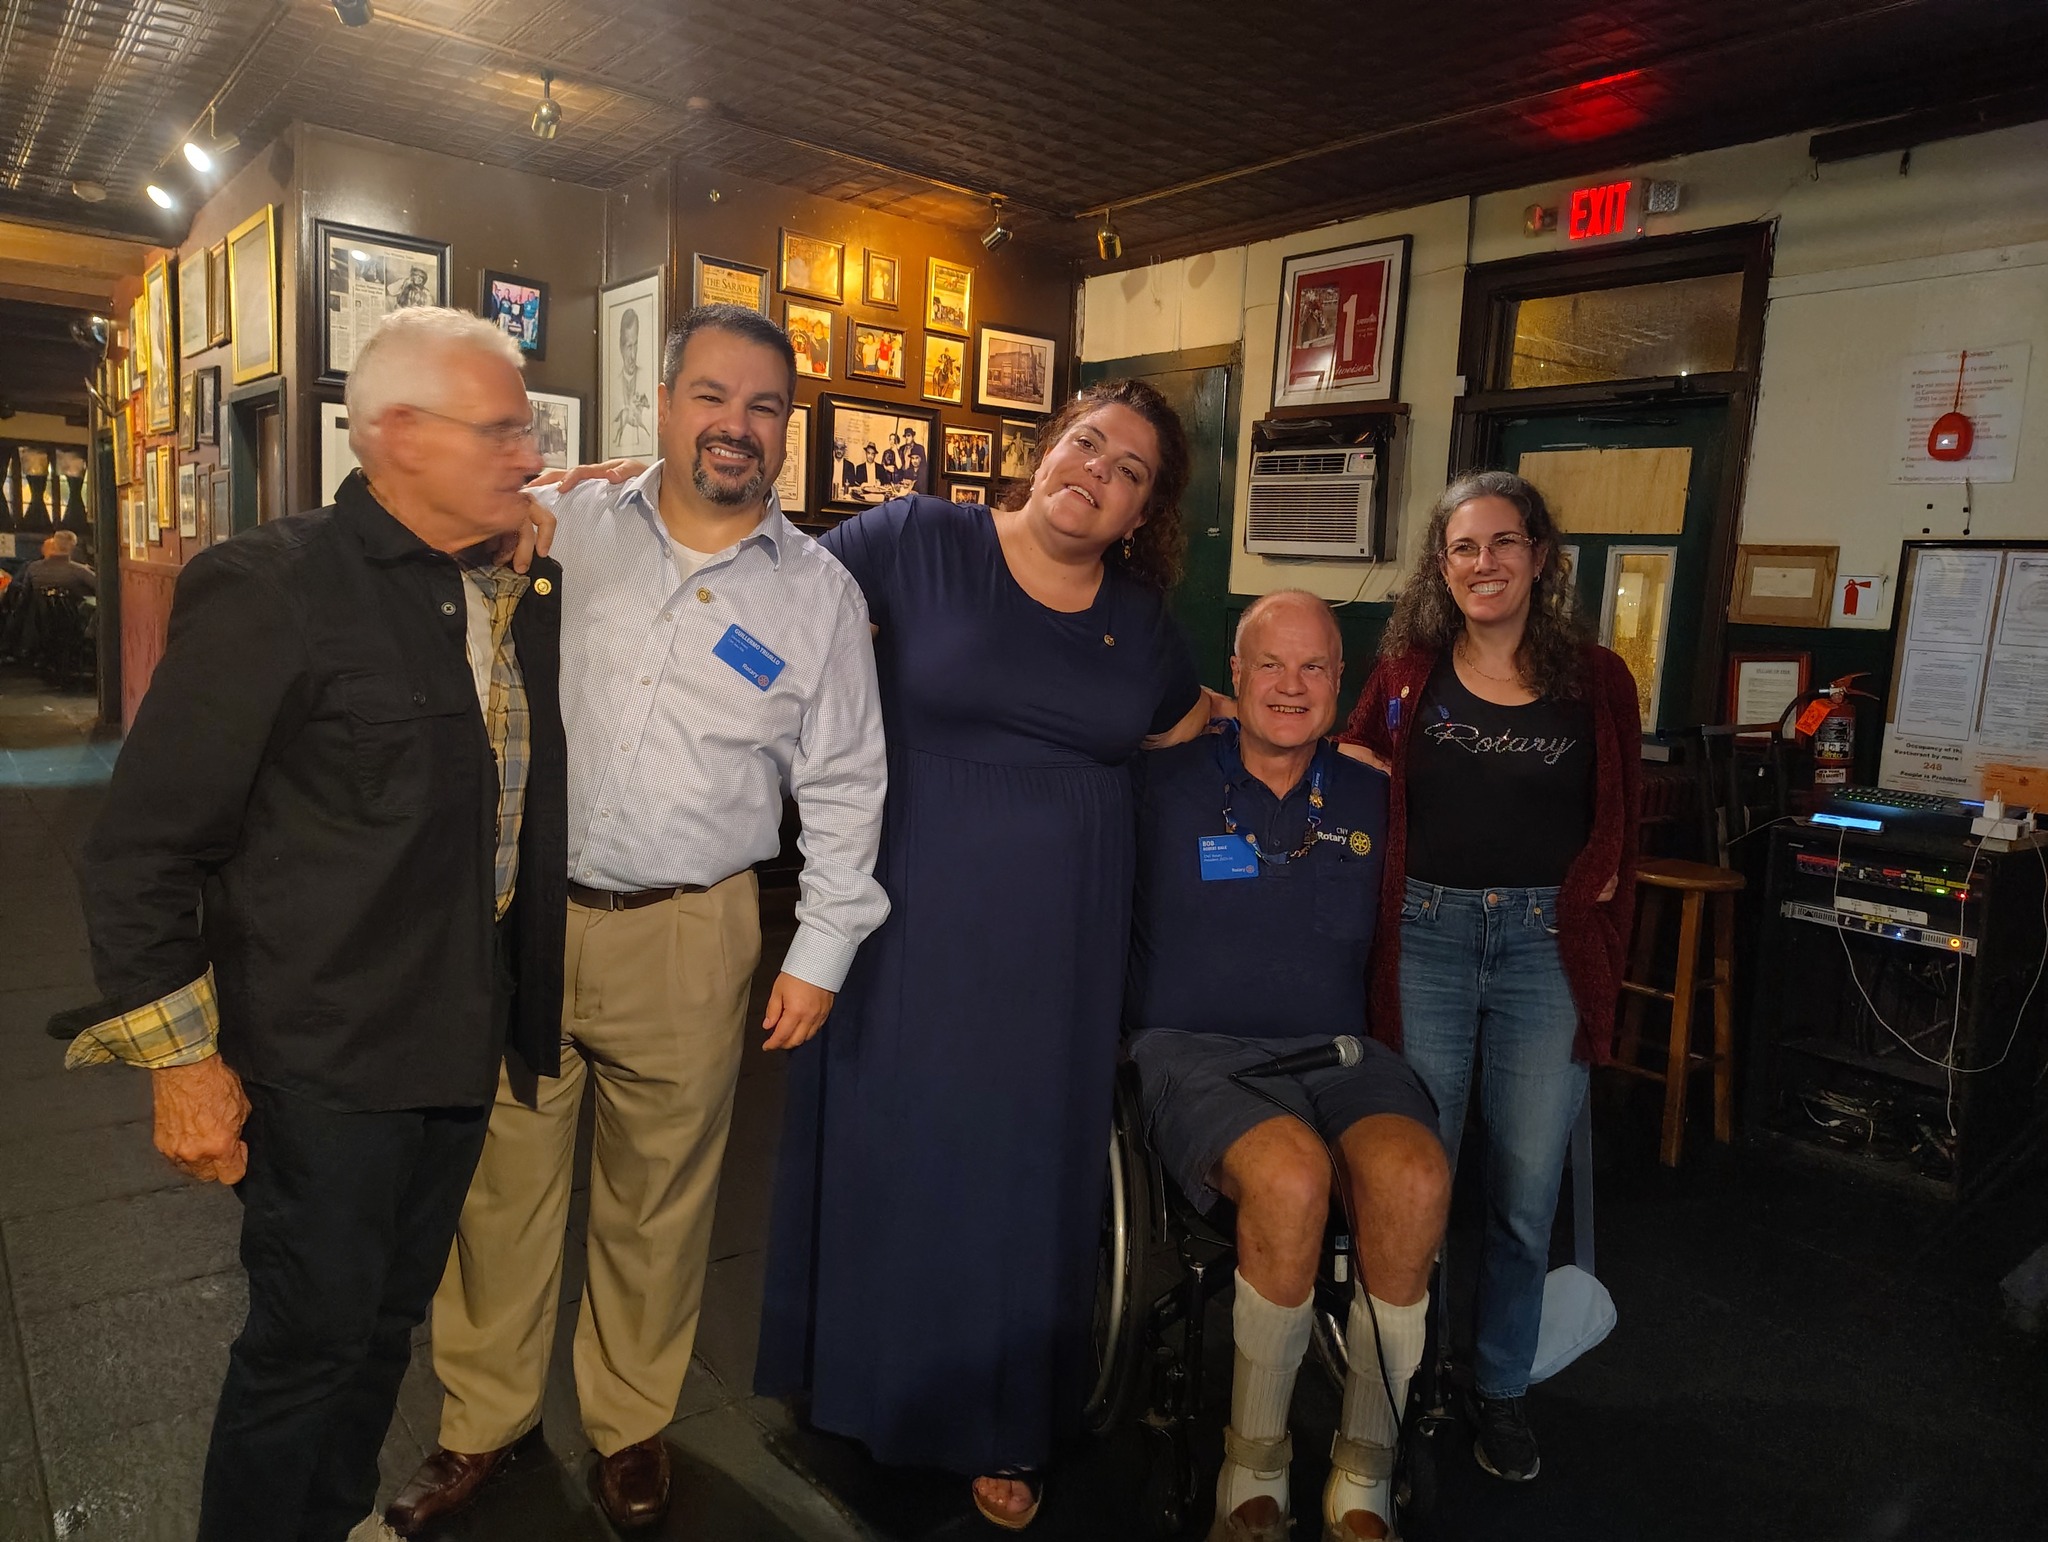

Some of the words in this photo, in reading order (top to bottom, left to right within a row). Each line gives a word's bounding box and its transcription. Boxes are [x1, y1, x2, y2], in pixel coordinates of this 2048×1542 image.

[1570, 180, 1632, 239] EXIT
[1343, 294, 1357, 361] 1
[742, 663, 759, 679] Rotary
[1425, 722, 1577, 765] Rotary
[1906, 742, 1942, 752] Occupancy
[1900, 770, 1922, 778] People
[1931, 775, 1967, 783] Prohibited
[1317, 831, 1347, 845] Rotary
